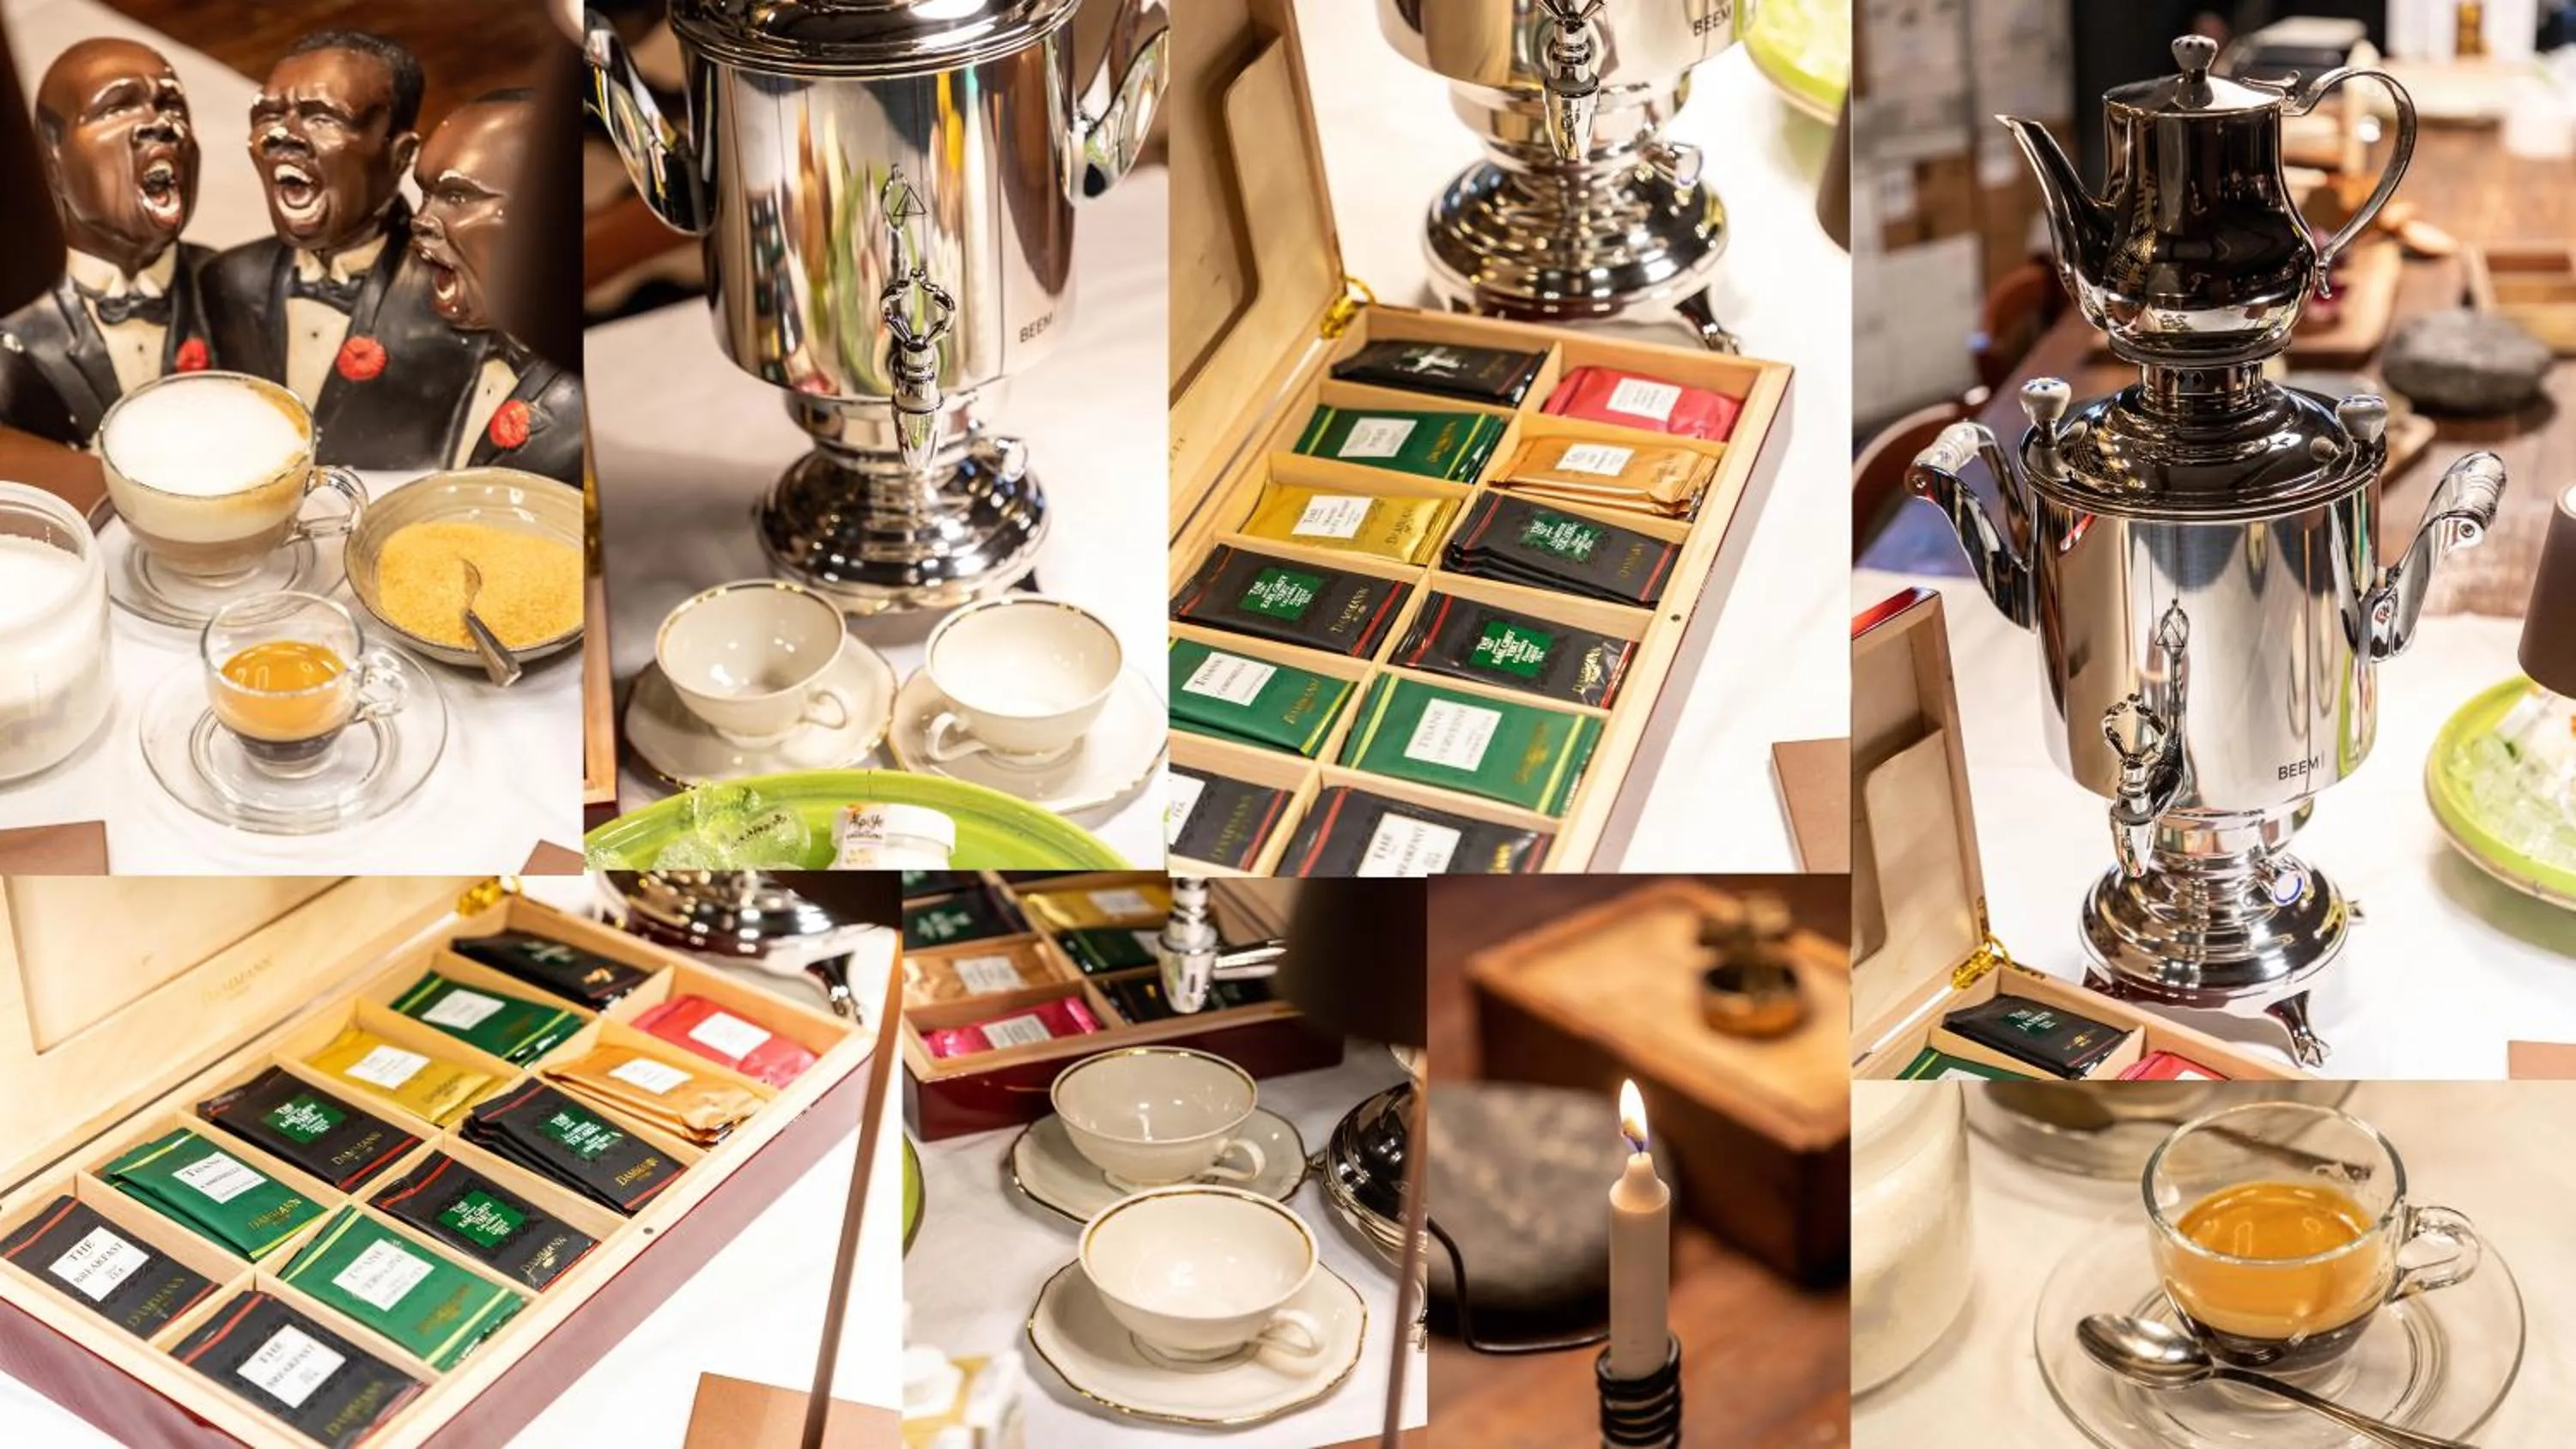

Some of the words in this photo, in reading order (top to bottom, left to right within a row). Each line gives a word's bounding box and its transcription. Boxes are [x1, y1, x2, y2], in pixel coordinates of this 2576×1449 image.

[1693, 4, 1732, 37] BEEM
[1019, 311, 1054, 343] BEEM
[2277, 755, 2319, 780] BEEM
[67, 1240, 95, 1262] THE
